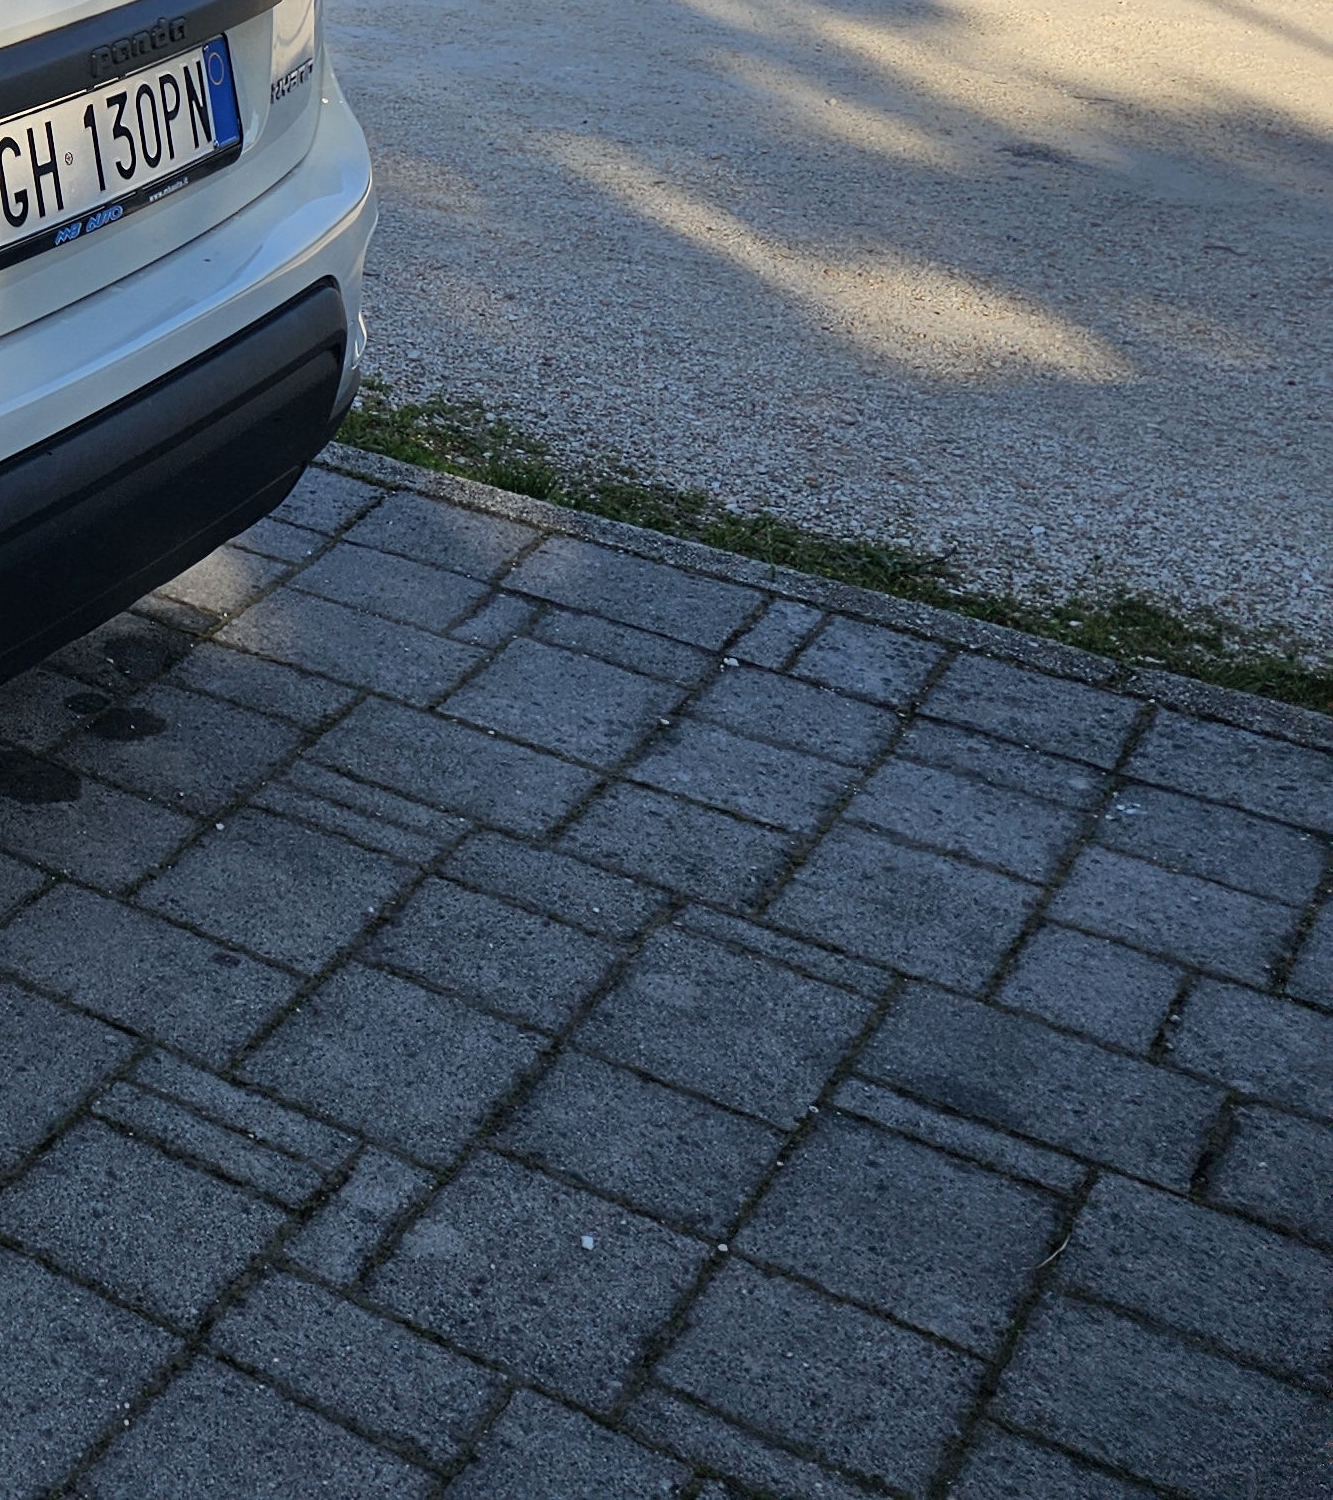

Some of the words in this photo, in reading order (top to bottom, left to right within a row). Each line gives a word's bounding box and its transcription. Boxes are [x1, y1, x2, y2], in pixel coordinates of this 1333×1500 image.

[90, 16, 187, 79] panda
[83, 60, 213, 192] 130PN
[86, 205, 124, 233] AUTO
